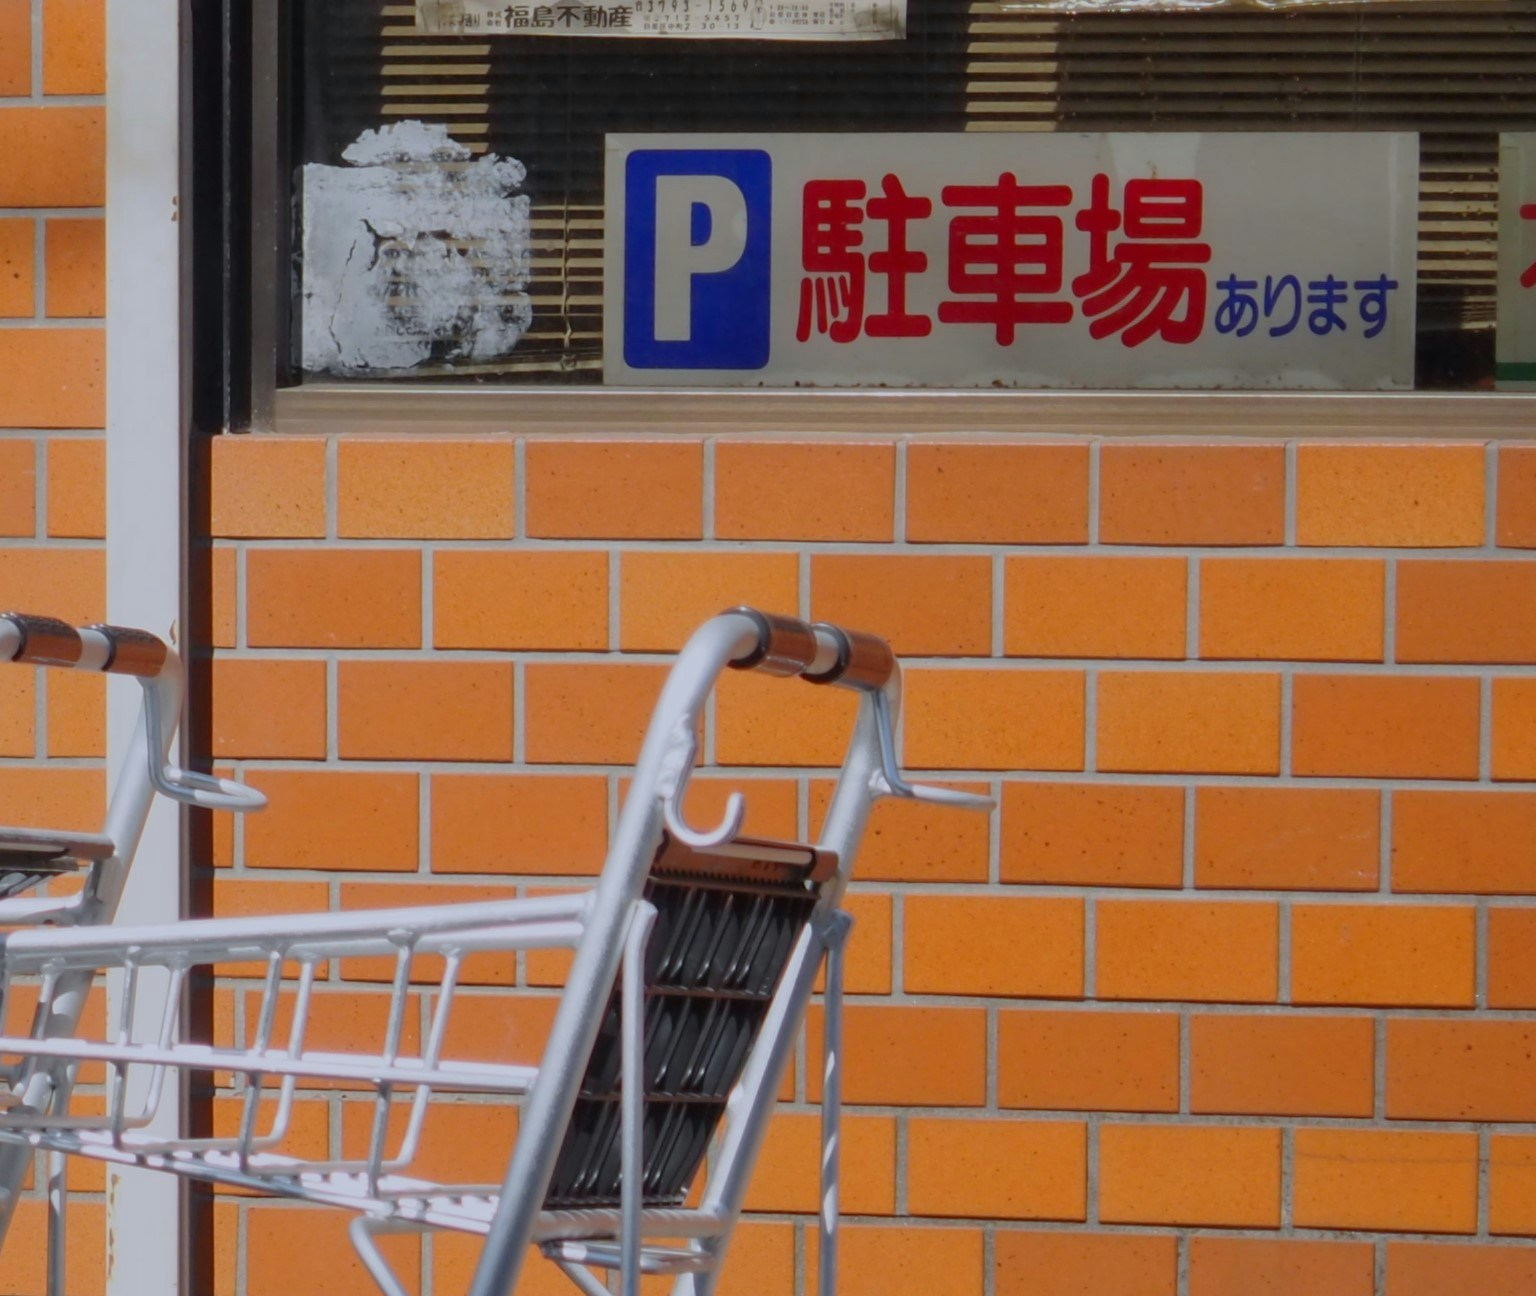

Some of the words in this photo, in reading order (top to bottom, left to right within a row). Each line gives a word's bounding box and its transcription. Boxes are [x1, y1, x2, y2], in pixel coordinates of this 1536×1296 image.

[504, 5, 633, 28] 福島不動産
[655, 174, 748, 341] P
